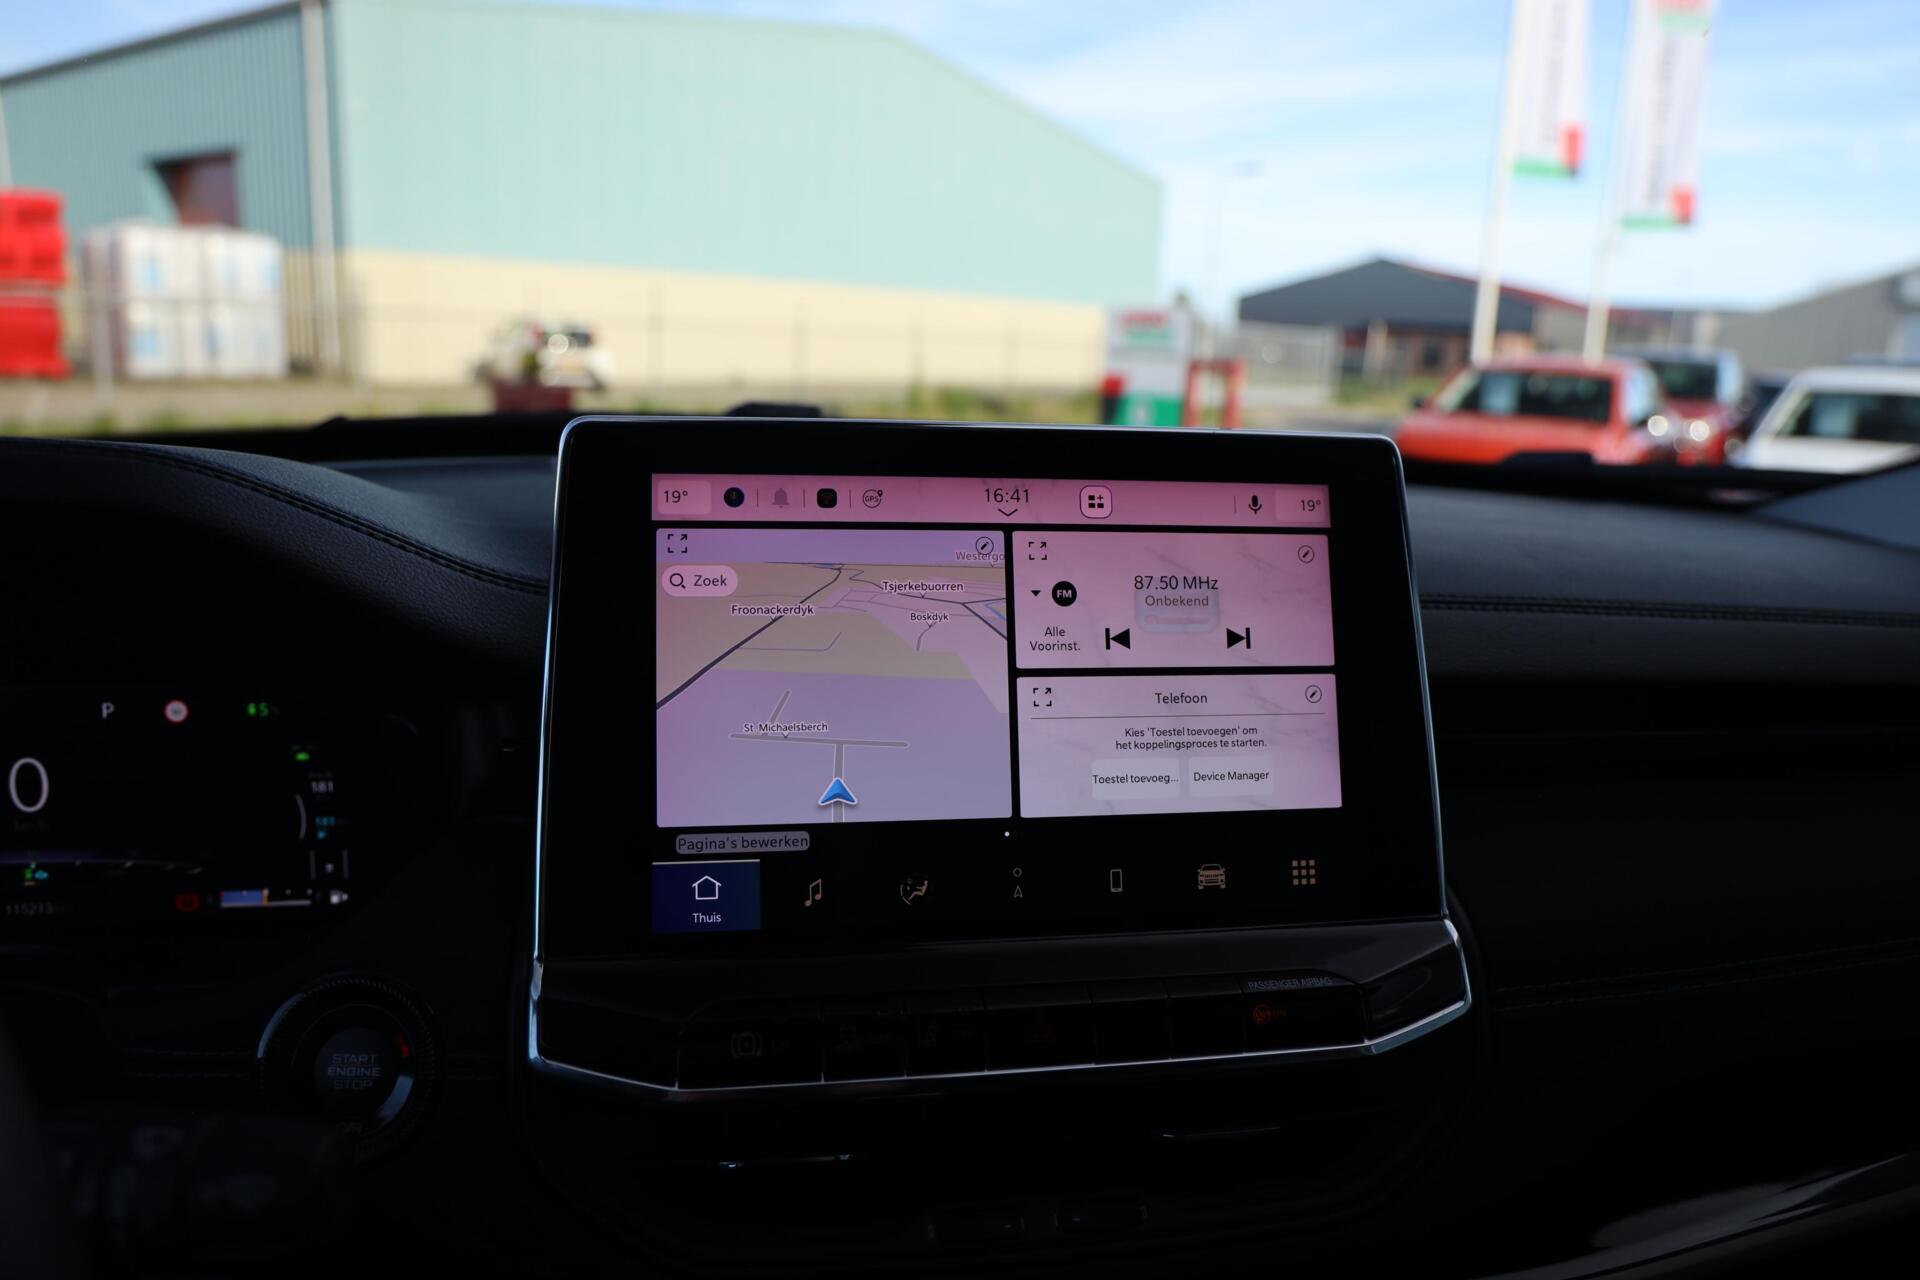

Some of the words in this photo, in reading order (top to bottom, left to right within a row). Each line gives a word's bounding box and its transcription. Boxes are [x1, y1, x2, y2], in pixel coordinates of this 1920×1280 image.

[663, 490, 689, 504] 19°
[985, 488, 1029, 503] 16:41
[1300, 499, 1321, 513] 19°
[693, 574, 727, 587] Zoek
[1134, 575, 1178, 590] 87.50
[1183, 576, 1218, 590] MHz
[882, 581, 963, 594] Tsjerkebuorren
[1056, 589, 1072, 598] FM
[1145, 595, 1209, 606] Onbekend
[731, 604, 814, 617] Froonackerdyk
[910, 612, 949, 623] Boskdyk
[1044, 626, 1066, 637] Alle
[1029, 640, 1081, 651] Voorinst.
[1155, 692, 1208, 704] Telefoon
[743, 723, 757, 733] St.
[758, 721, 828, 732] Michaelsberch
[1124, 727, 1145, 737] Kies
[1147, 726, 1185, 737] 'Toestel
[1187, 725, 1240, 738] toevoegen'
[1242, 727, 1258, 735] om
[1115, 740, 1131, 750] het
[1133, 739, 1218, 751] koppelingsproces
[1219, 739, 1230, 748] te
[1231, 738, 1267, 748] starten.
[1092, 774, 1129, 784] Toestel
[1130, 774, 1179, 785] toevoeg...
[1193, 771, 1225, 782] Device
[1227, 770, 1269, 784] Manager
[8, 757, 50, 813] 0
[678, 836, 738, 852] Pagina's
[741, 835, 809, 849] bewerken
[692, 912, 722, 923] Thuis
[1247, 979, 1299, 991] PASSENGER
[1300, 976, 1333, 987] AIRBAG
[332, 1053, 378, 1064] START
[327, 1066, 382, 1077] ENGINE
[334, 1078, 373, 1090] STOP
